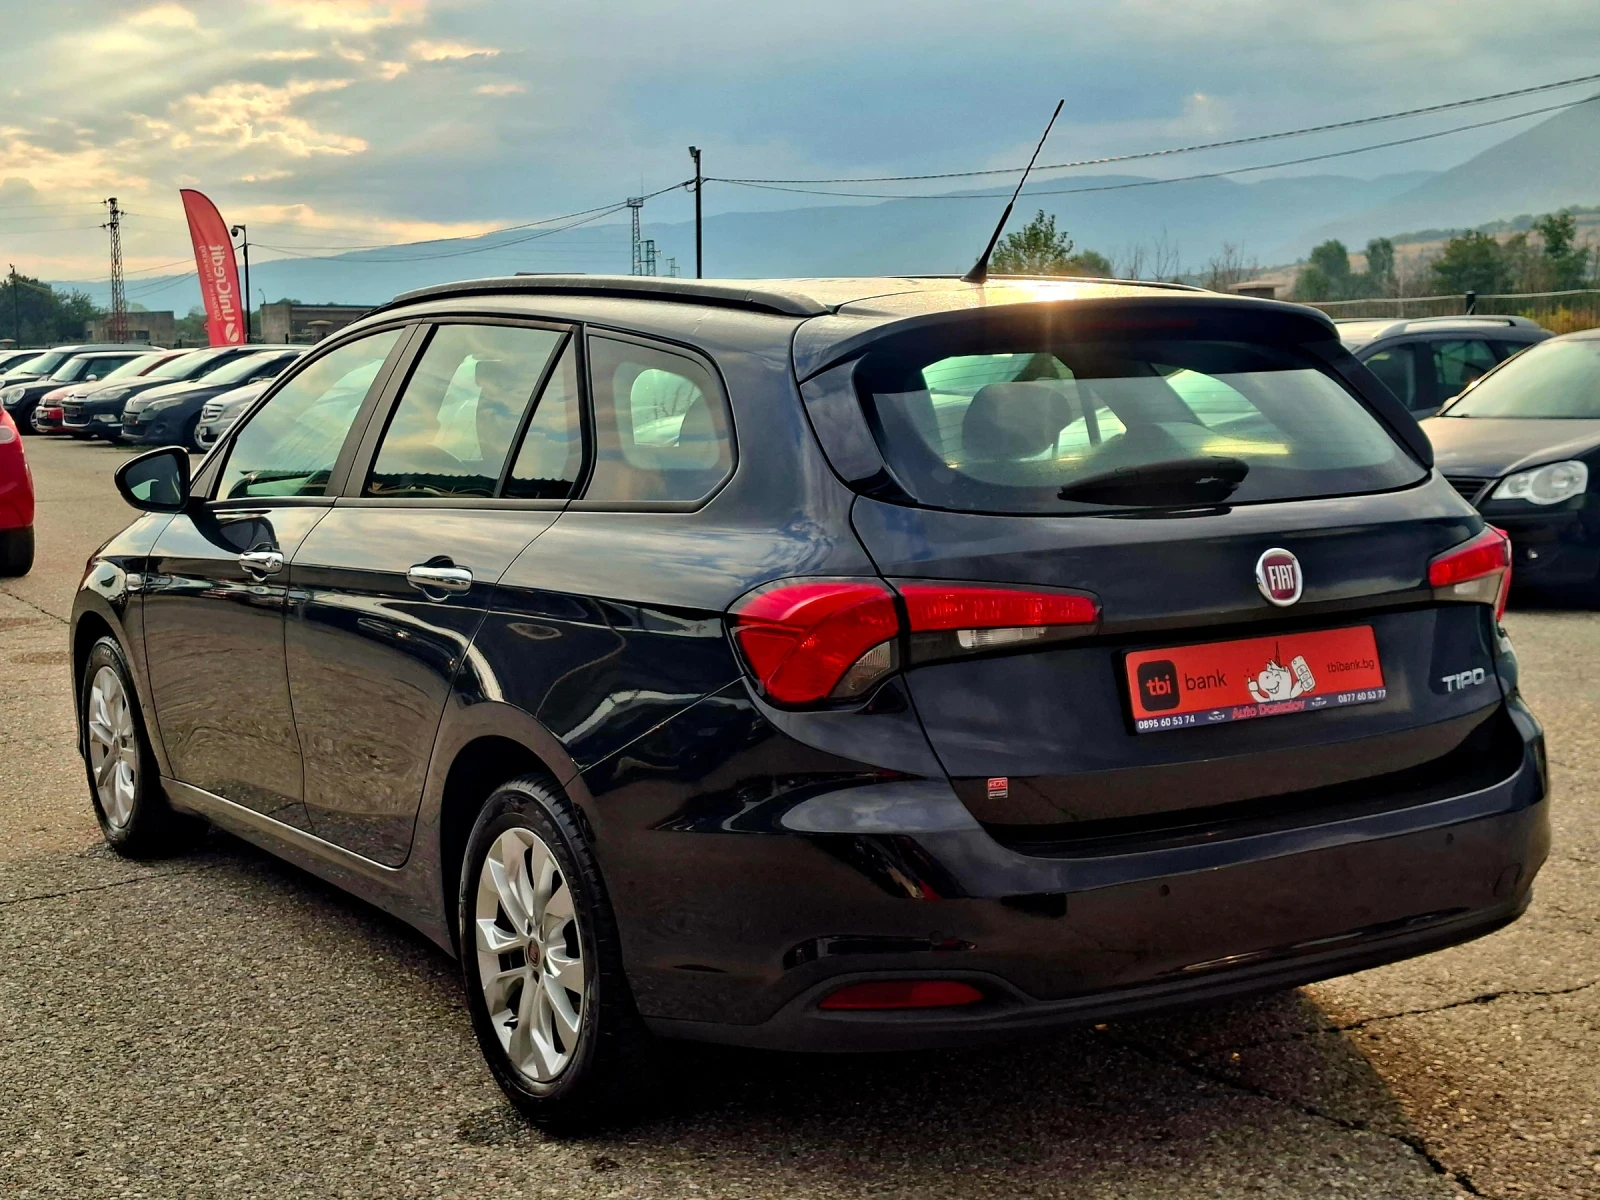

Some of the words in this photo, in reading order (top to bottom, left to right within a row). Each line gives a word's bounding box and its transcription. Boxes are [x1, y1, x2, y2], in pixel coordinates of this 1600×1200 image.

[1268, 564, 1294, 590] FIAT
[1327, 658, 1375, 673] tbibank.bg
[1146, 674, 1171, 696] tbi
[1185, 669, 1228, 691] bank
[1442, 667, 1485, 692] TIPO
[1338, 693, 1355, 703] 0877
[1357, 692, 1367, 701] 60
[1367, 690, 1377, 699] 53
[1377, 689, 1386, 698] 77
[1232, 705, 1257, 719] Auto
[1138, 718, 1159, 729] 0895
[1161, 717, 1171, 727] 60
[1173, 716, 1183, 725] 53
[1185, 714, 1195, 724] 74
